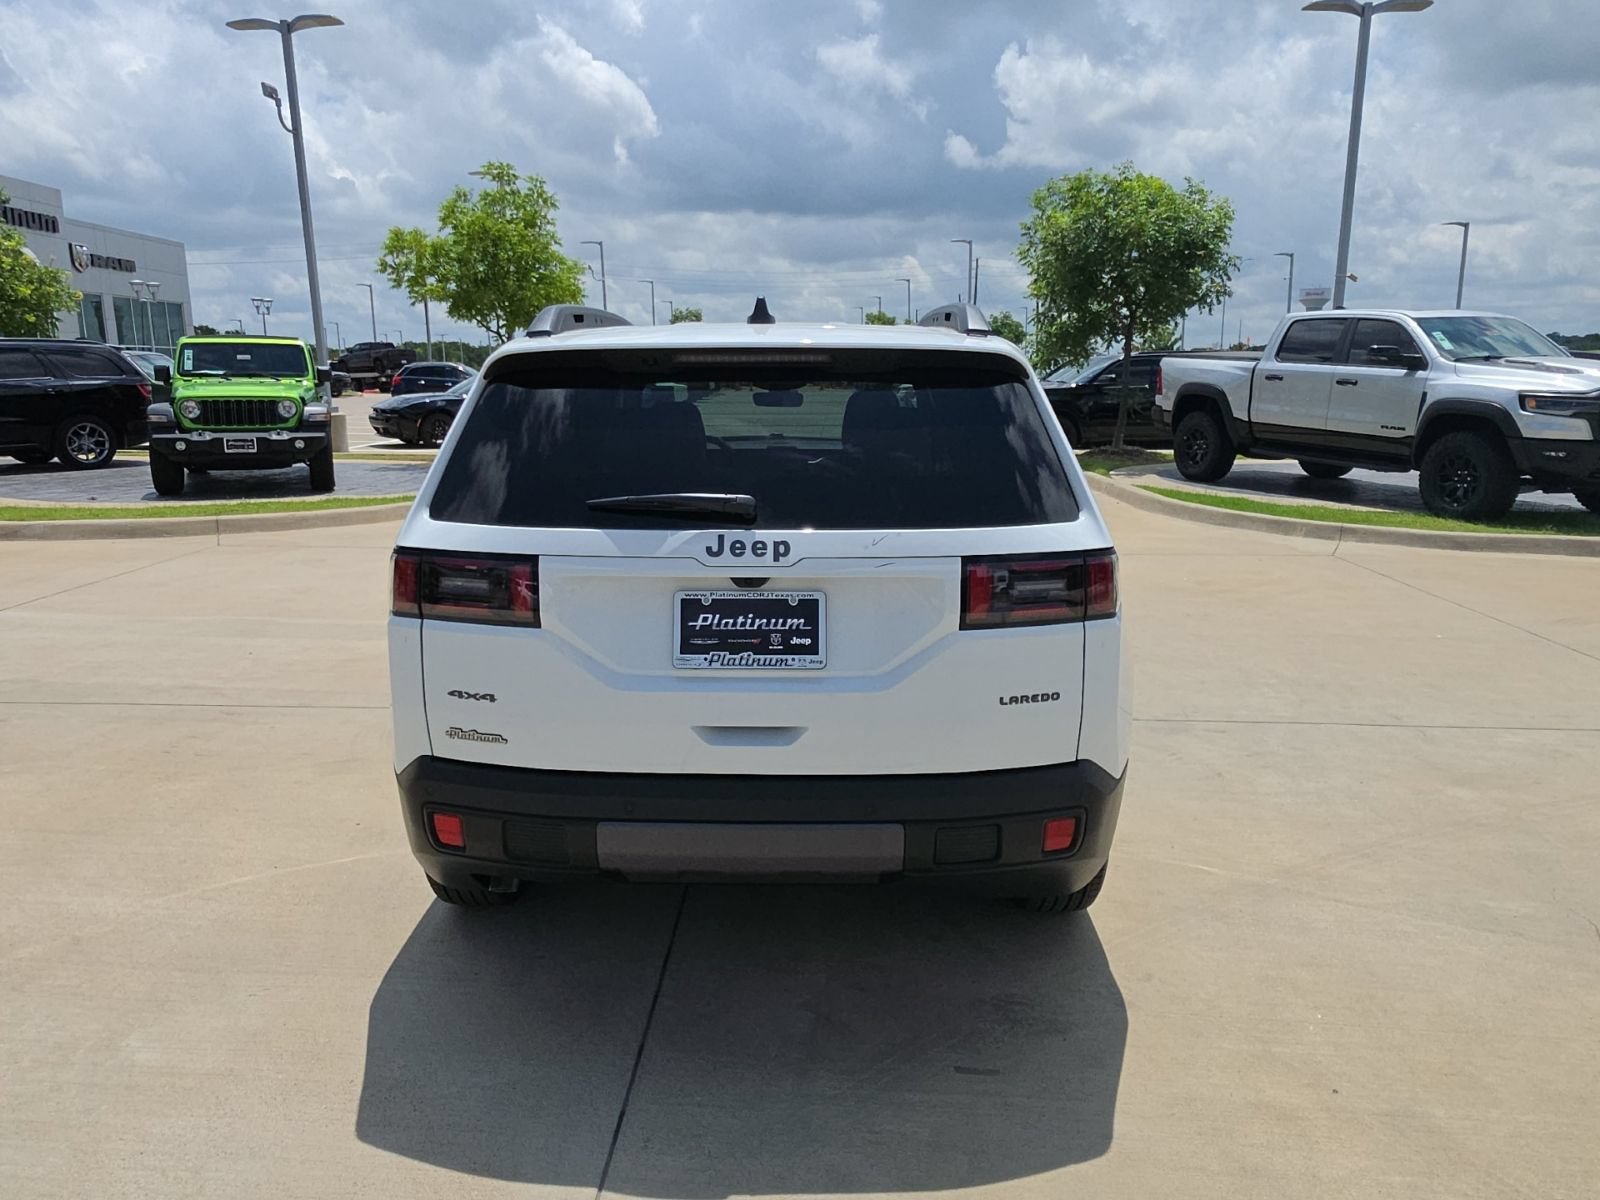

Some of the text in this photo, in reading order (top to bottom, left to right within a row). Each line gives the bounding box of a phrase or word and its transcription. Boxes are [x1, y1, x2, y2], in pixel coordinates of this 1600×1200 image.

[90, 253, 137, 273] RAM
[705, 534, 791, 562] Jeep
[687, 613, 812, 630] Platinum
[789, 636, 812, 646] Jeep
[707, 653, 795, 667] Platinum
[999, 691, 1061, 706] LAREDO
[445, 726, 508, 744] Platinum
